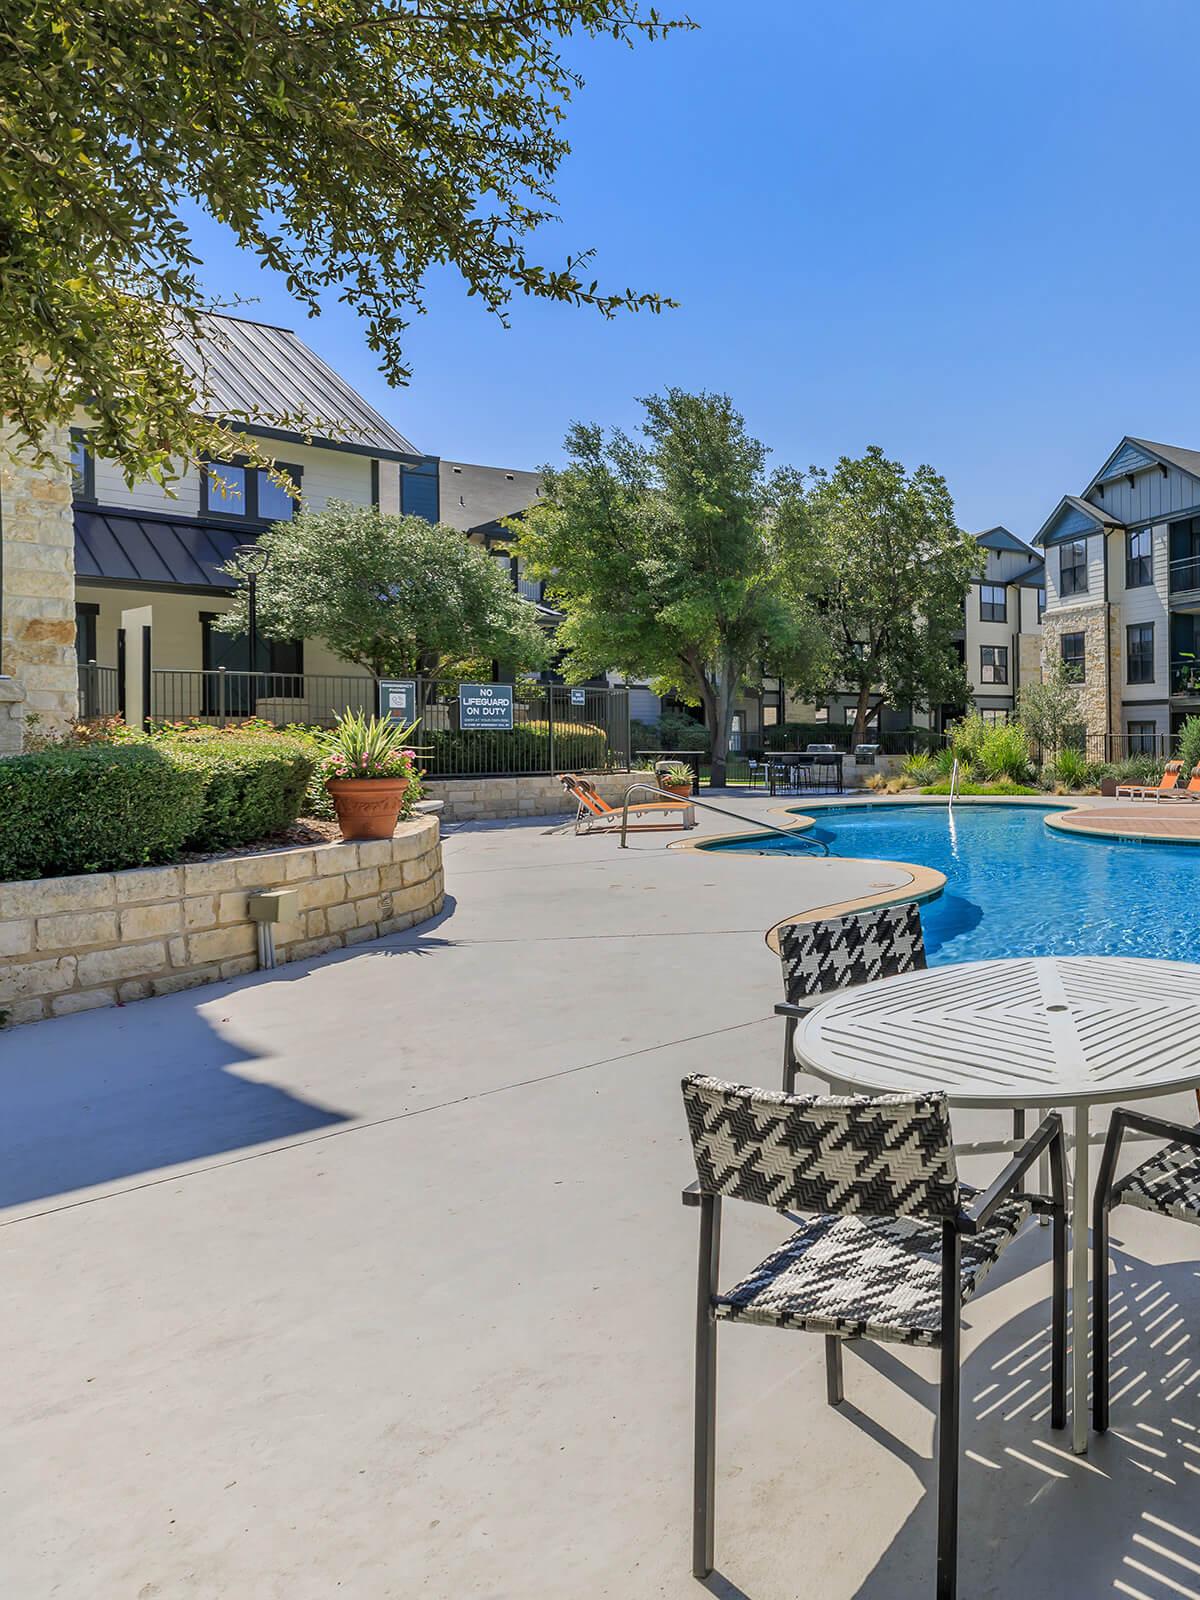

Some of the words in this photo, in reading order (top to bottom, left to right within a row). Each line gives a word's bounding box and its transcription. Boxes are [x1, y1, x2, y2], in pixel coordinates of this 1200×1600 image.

[479, 688, 493, 697] NO
[462, 697, 510, 706] LIFEGUARD
[466, 707, 480, 715] ON
[482, 707, 506, 715] DUTY
